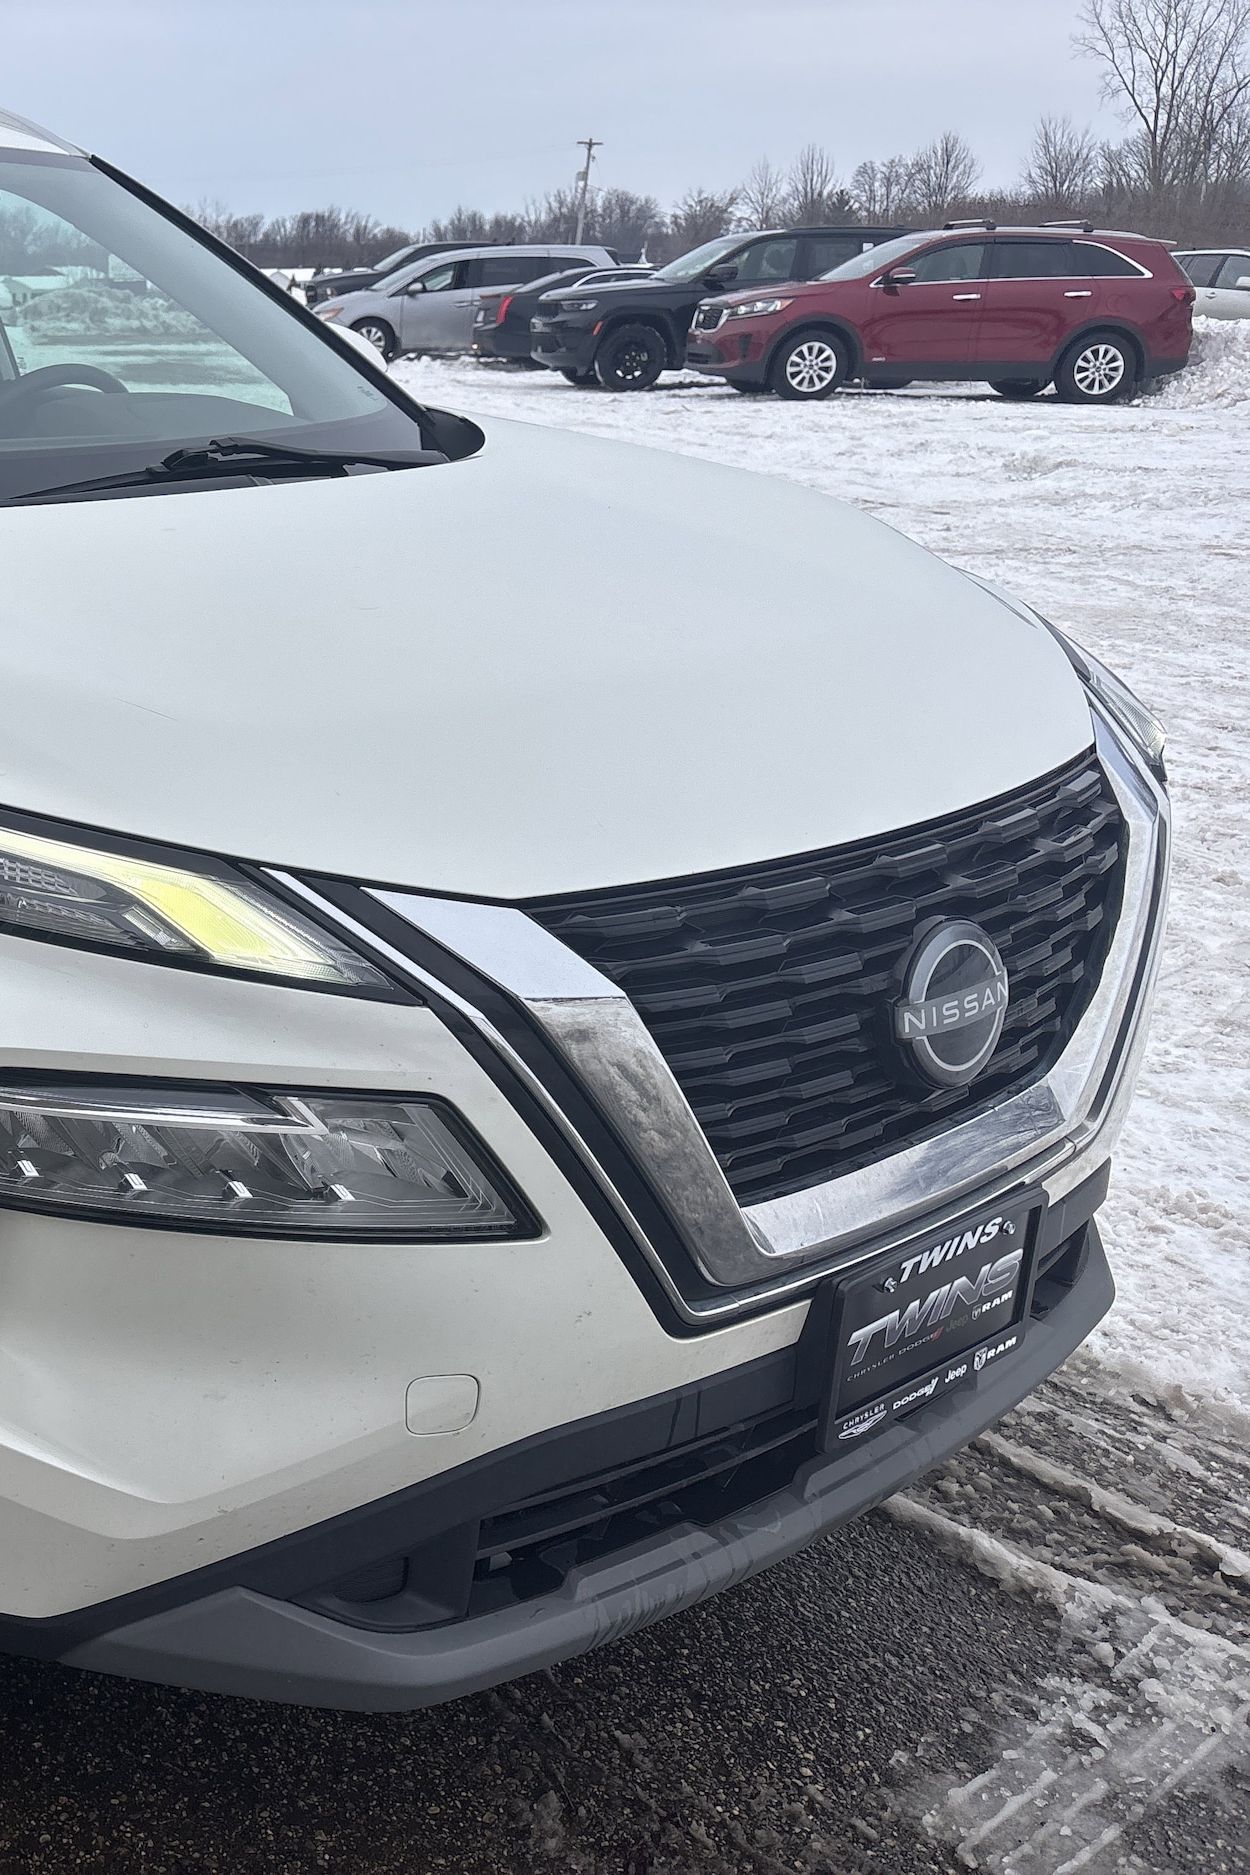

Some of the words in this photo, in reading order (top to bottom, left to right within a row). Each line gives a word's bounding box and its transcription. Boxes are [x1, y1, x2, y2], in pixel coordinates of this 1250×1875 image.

[904, 981, 1008, 1033] NISSAN
[900, 1216, 1003, 1283] TWINS
[846, 1353, 895, 1382] CHRYSLER
[898, 1332, 937, 1356] DODGE
[945, 1314, 969, 1334] Jeep
[981, 1289, 1013, 1313] RAM
[847, 1248, 1024, 1366] TWINS
[842, 1402, 885, 1430] CHRYSLER
[892, 1385, 932, 1410] DODGE
[944, 1363, 968, 1384] Jeep
[987, 1336, 1017, 1360] RAM
